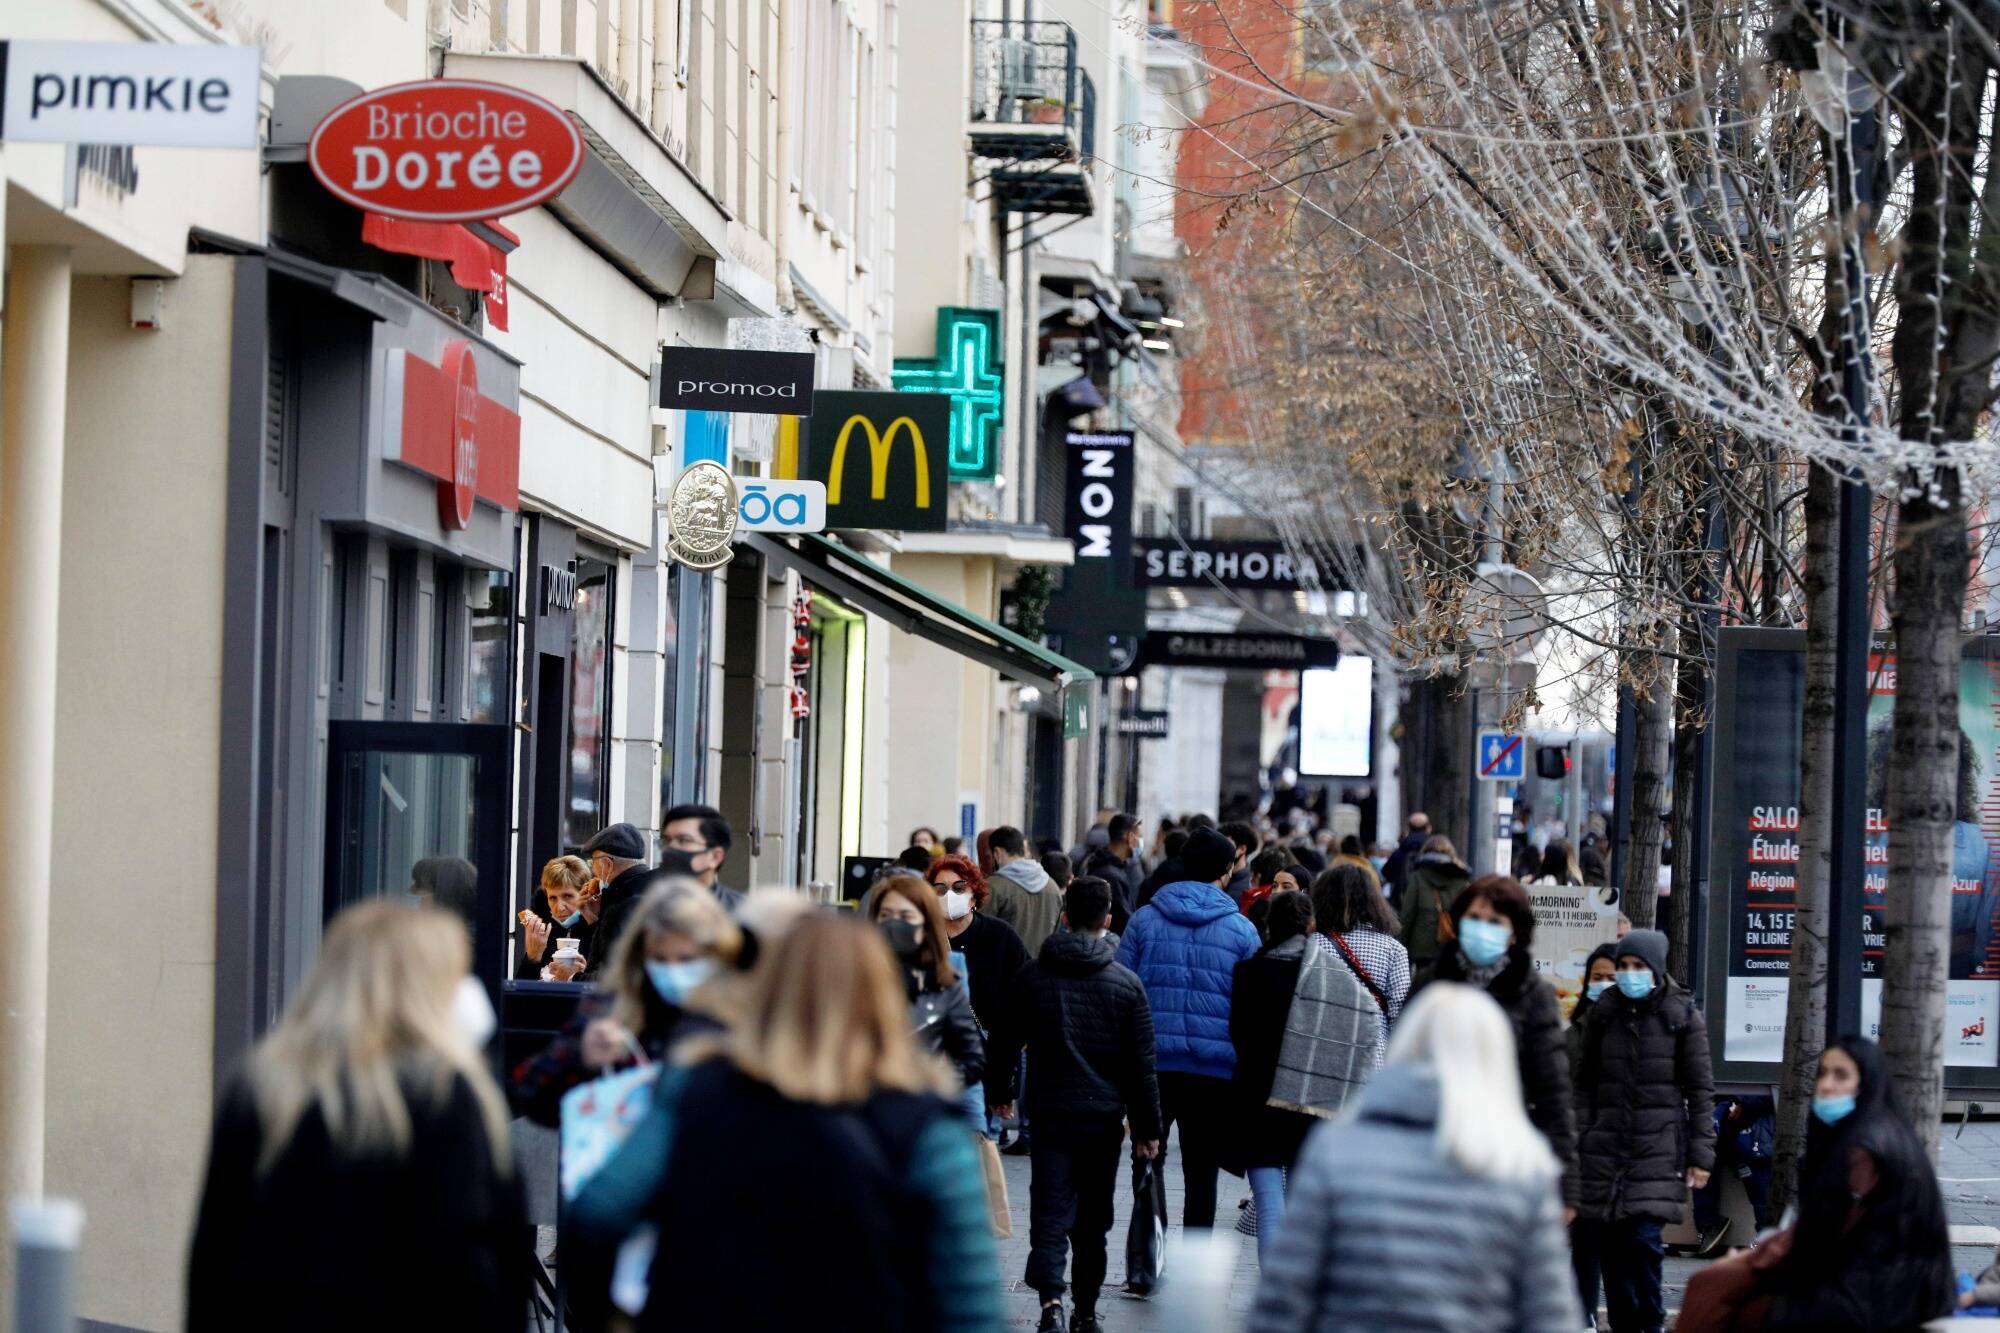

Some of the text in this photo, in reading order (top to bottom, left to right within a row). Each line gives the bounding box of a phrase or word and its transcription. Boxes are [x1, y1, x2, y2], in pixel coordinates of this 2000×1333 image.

[31, 72, 231, 120] pimkie
[367, 103, 527, 141] Brioche
[353, 143, 543, 190] Dorée
[677, 380, 796, 398] promod
[673, 544, 724, 563] NOTAIRE
[1146, 549, 1320, 581] SEPHORA
[1167, 635, 1306, 660] CALZEDONIA
[1750, 871, 1795, 892] Région
[1769, 913, 1783, 929] 15
[1747, 932, 1759, 945] EN
[1761, 932, 1790, 945] LIGNE
